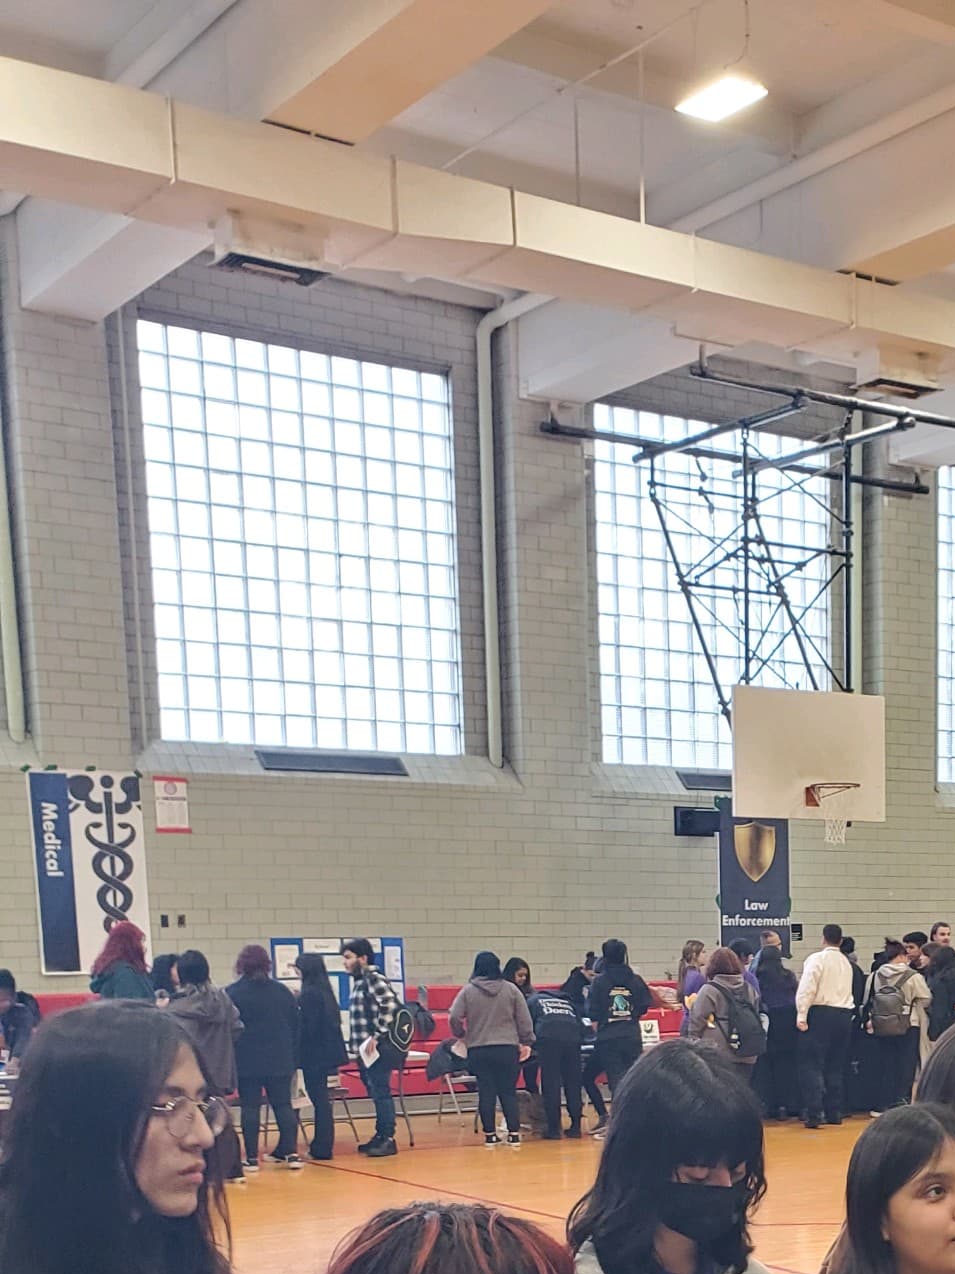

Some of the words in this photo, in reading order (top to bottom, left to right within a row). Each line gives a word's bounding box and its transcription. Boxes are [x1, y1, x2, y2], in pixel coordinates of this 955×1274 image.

[40, 801, 65, 878] Medical
[744, 898, 769, 911] Law
[722, 914, 790, 927] Enforcement
